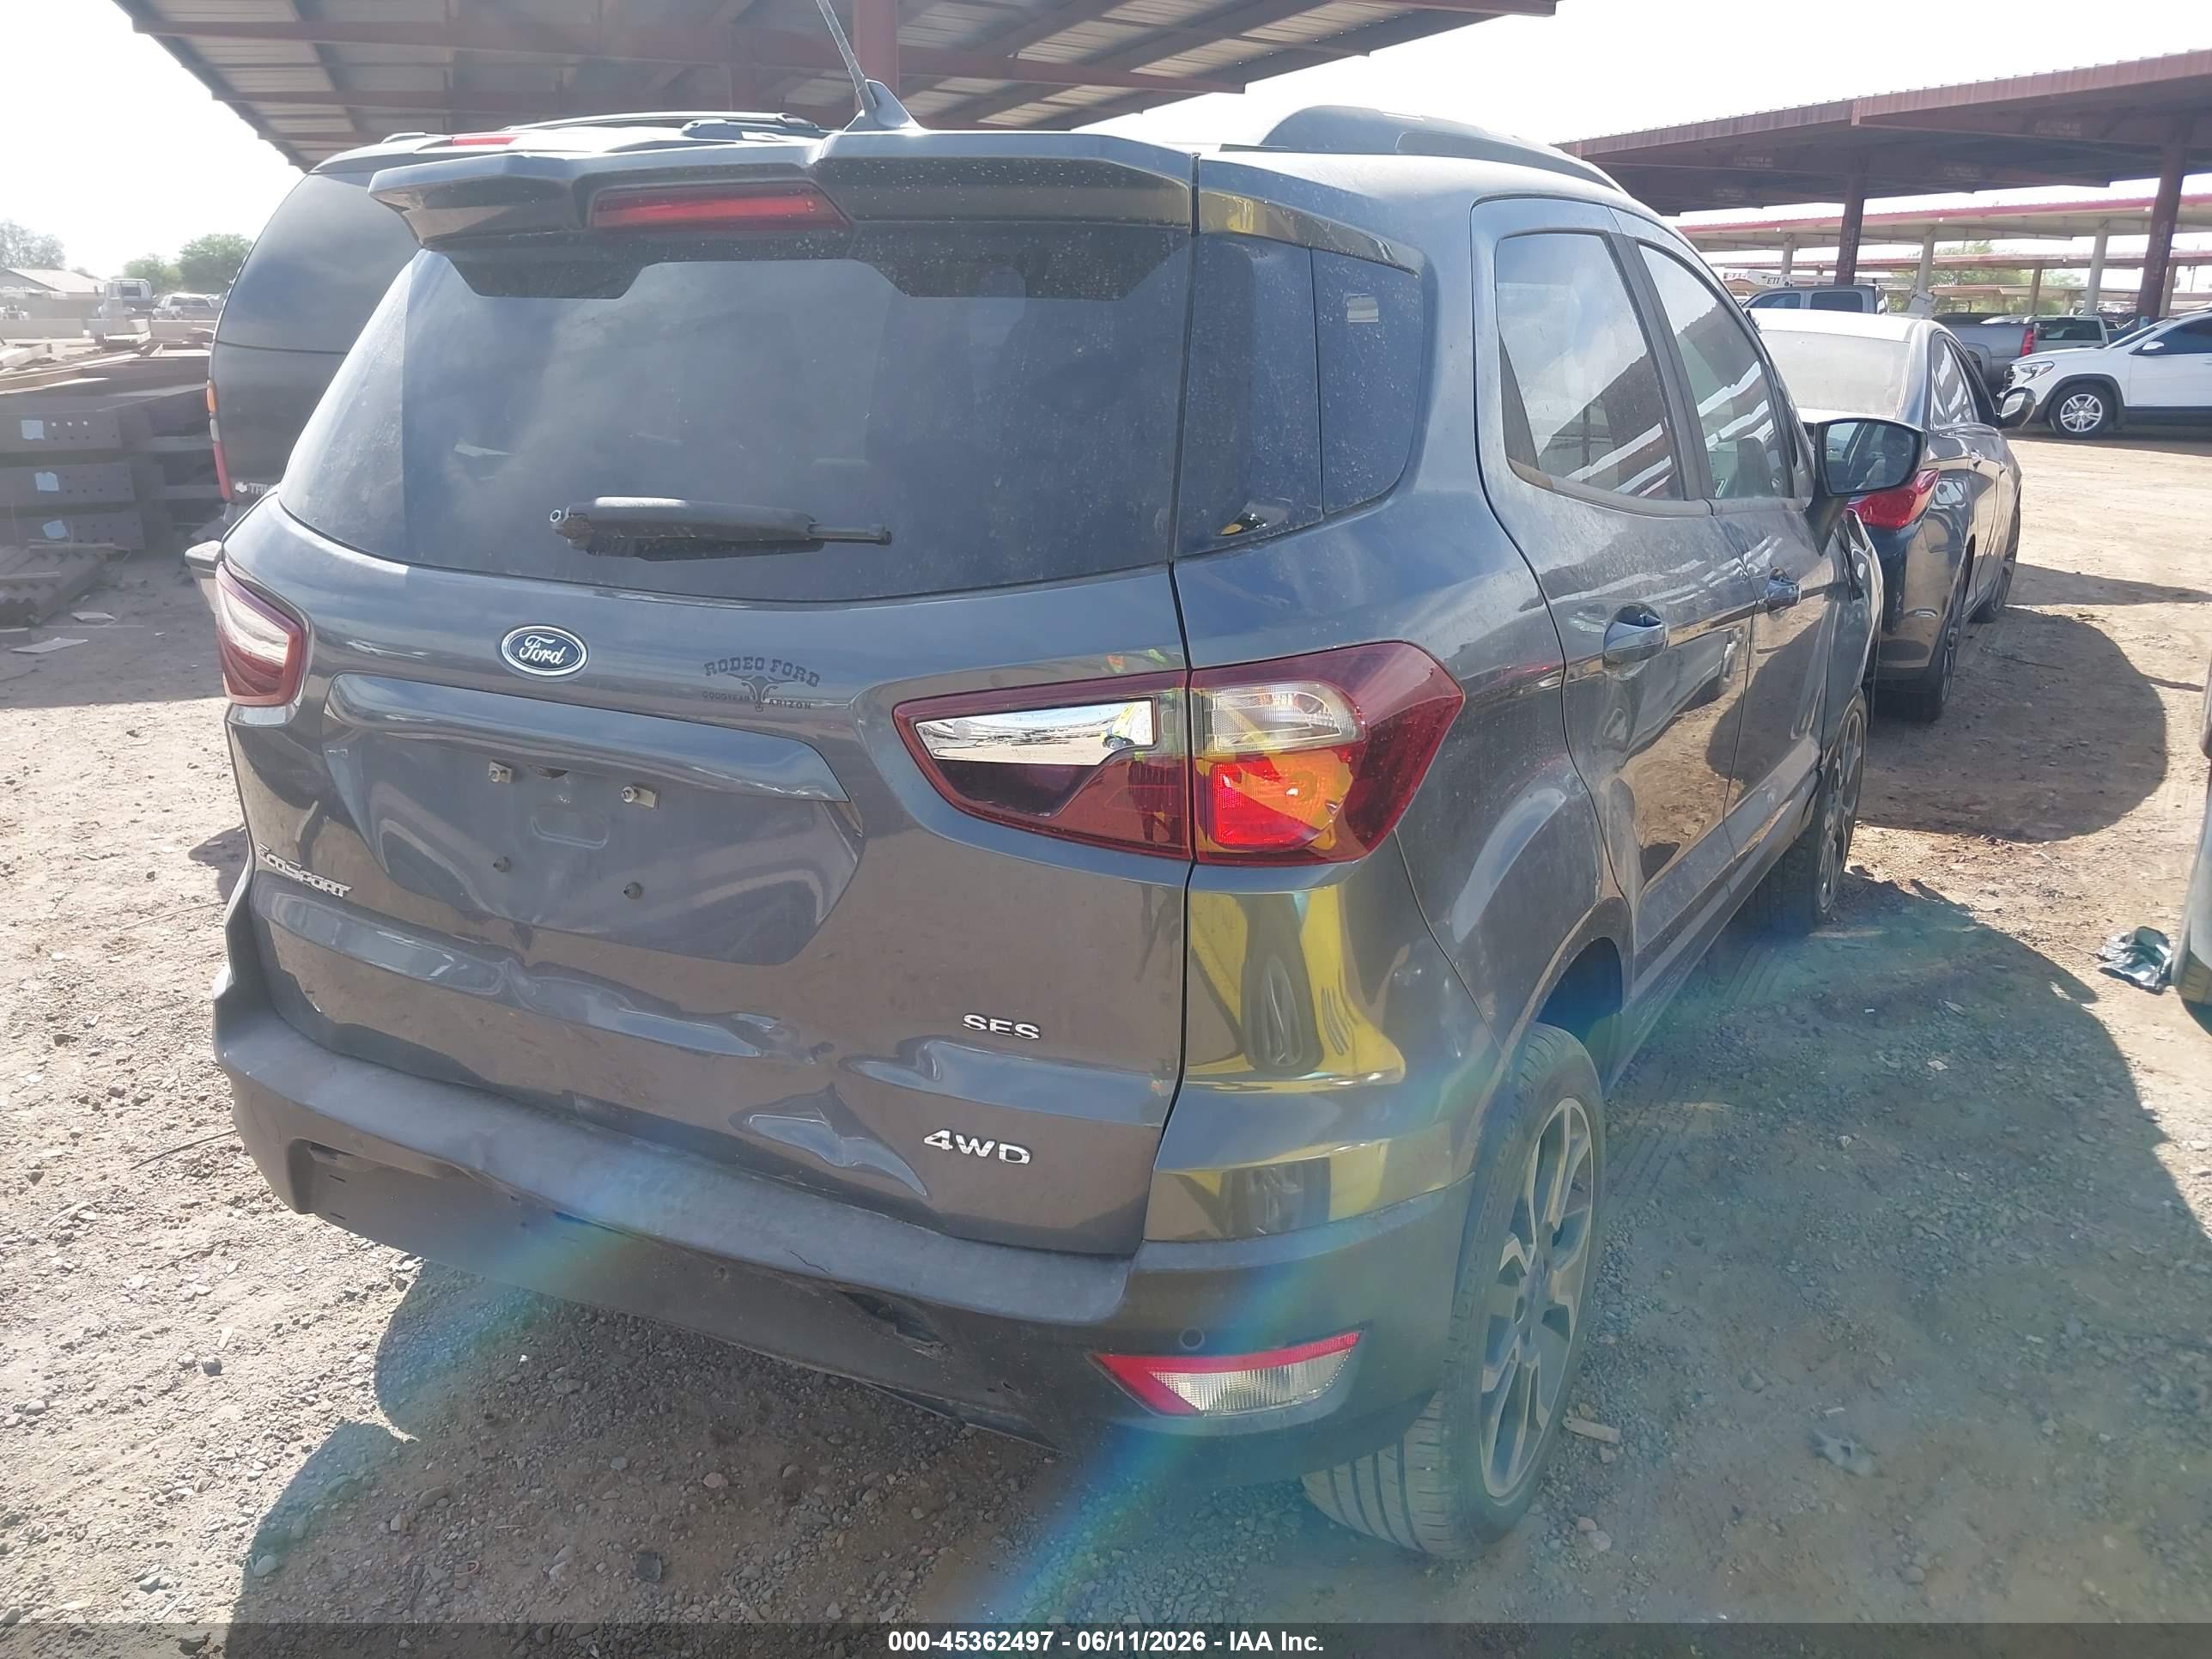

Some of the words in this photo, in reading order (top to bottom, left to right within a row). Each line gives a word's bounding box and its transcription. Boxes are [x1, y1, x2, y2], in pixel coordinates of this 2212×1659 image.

[519, 635, 568, 665] Ford
[704, 656, 765, 677] RODEO
[769, 659, 821, 687] FORD
[962, 1013, 1042, 1040] SES
[923, 1129, 1031, 1164] 4WD
